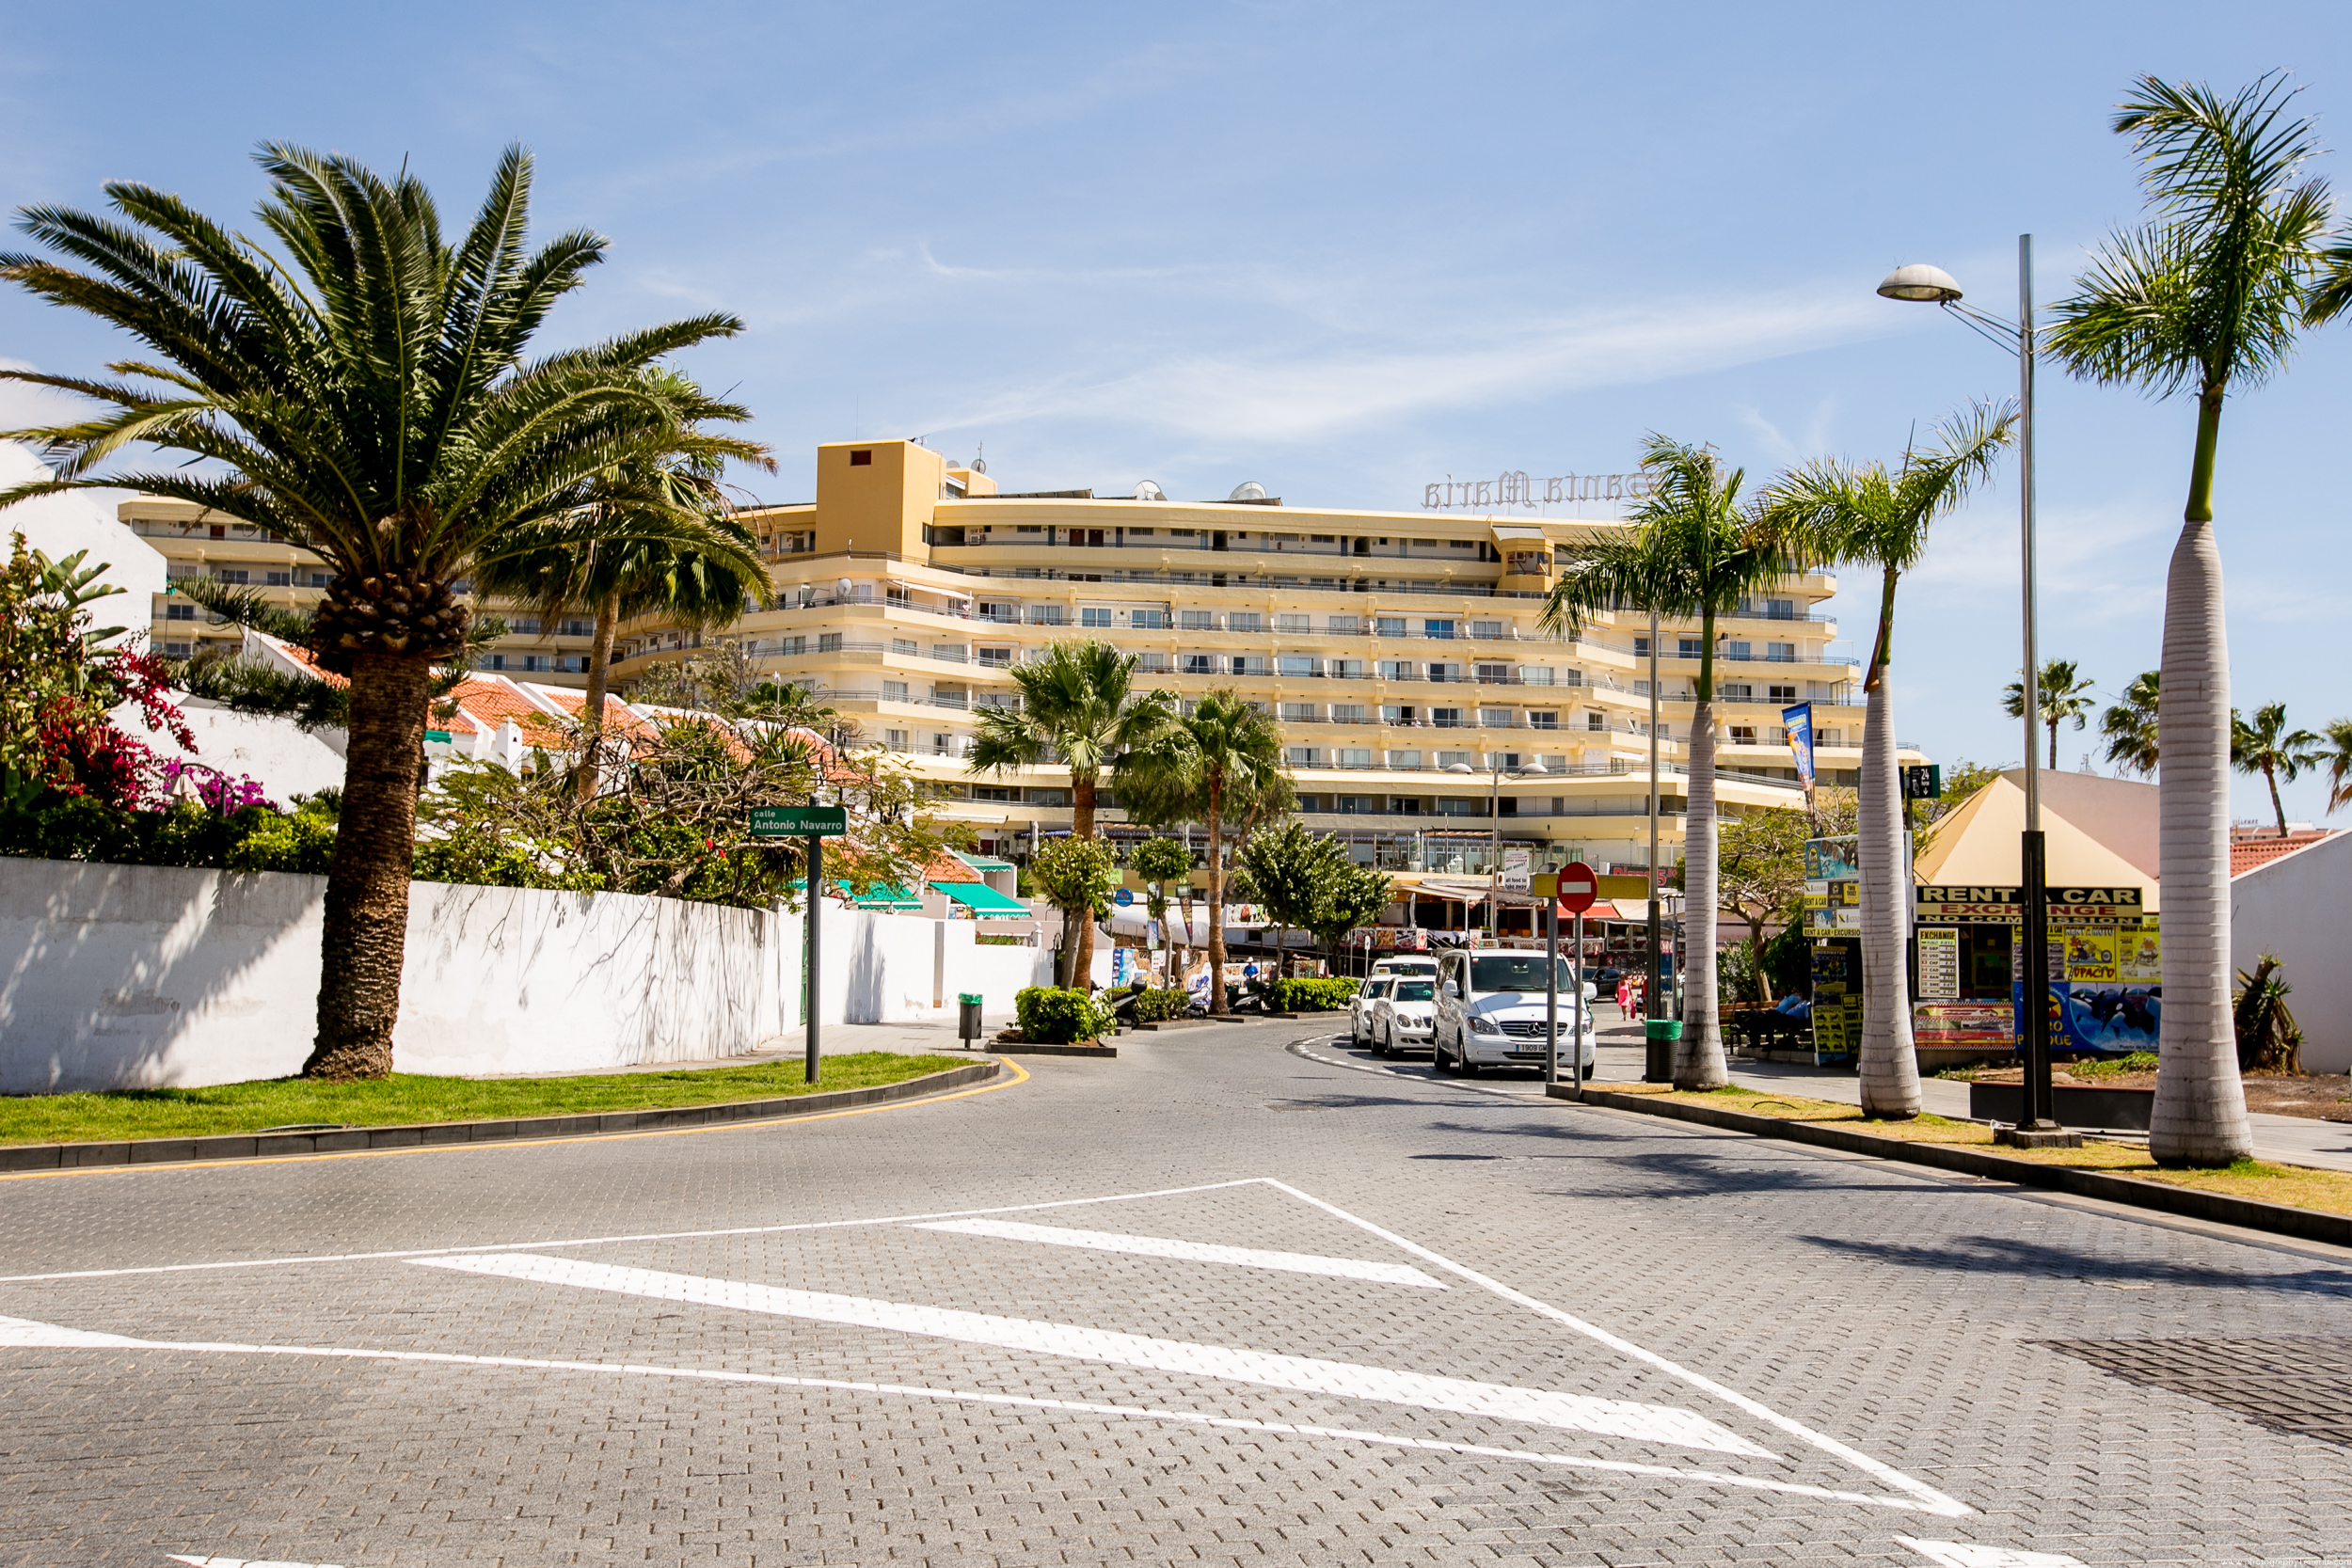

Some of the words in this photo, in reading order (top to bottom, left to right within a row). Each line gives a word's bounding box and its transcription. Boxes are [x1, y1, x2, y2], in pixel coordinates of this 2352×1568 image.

[1920, 768, 1931, 780] 24
[754, 819, 796, 830] Antonio
[800, 819, 843, 830] Navarro
[1923, 887, 2016, 901] RENT
[2062, 889, 2136, 903] CAR
[1804, 897, 1814, 906] RENT
[1940, 904, 2117, 916] EXCHNGE
[1968, 915, 2134, 924] COMISSION
[1921, 931, 1956, 940] EXCHANGE
[2065, 927, 2085, 936] RENT
[2093, 927, 2115, 936] MOTO
